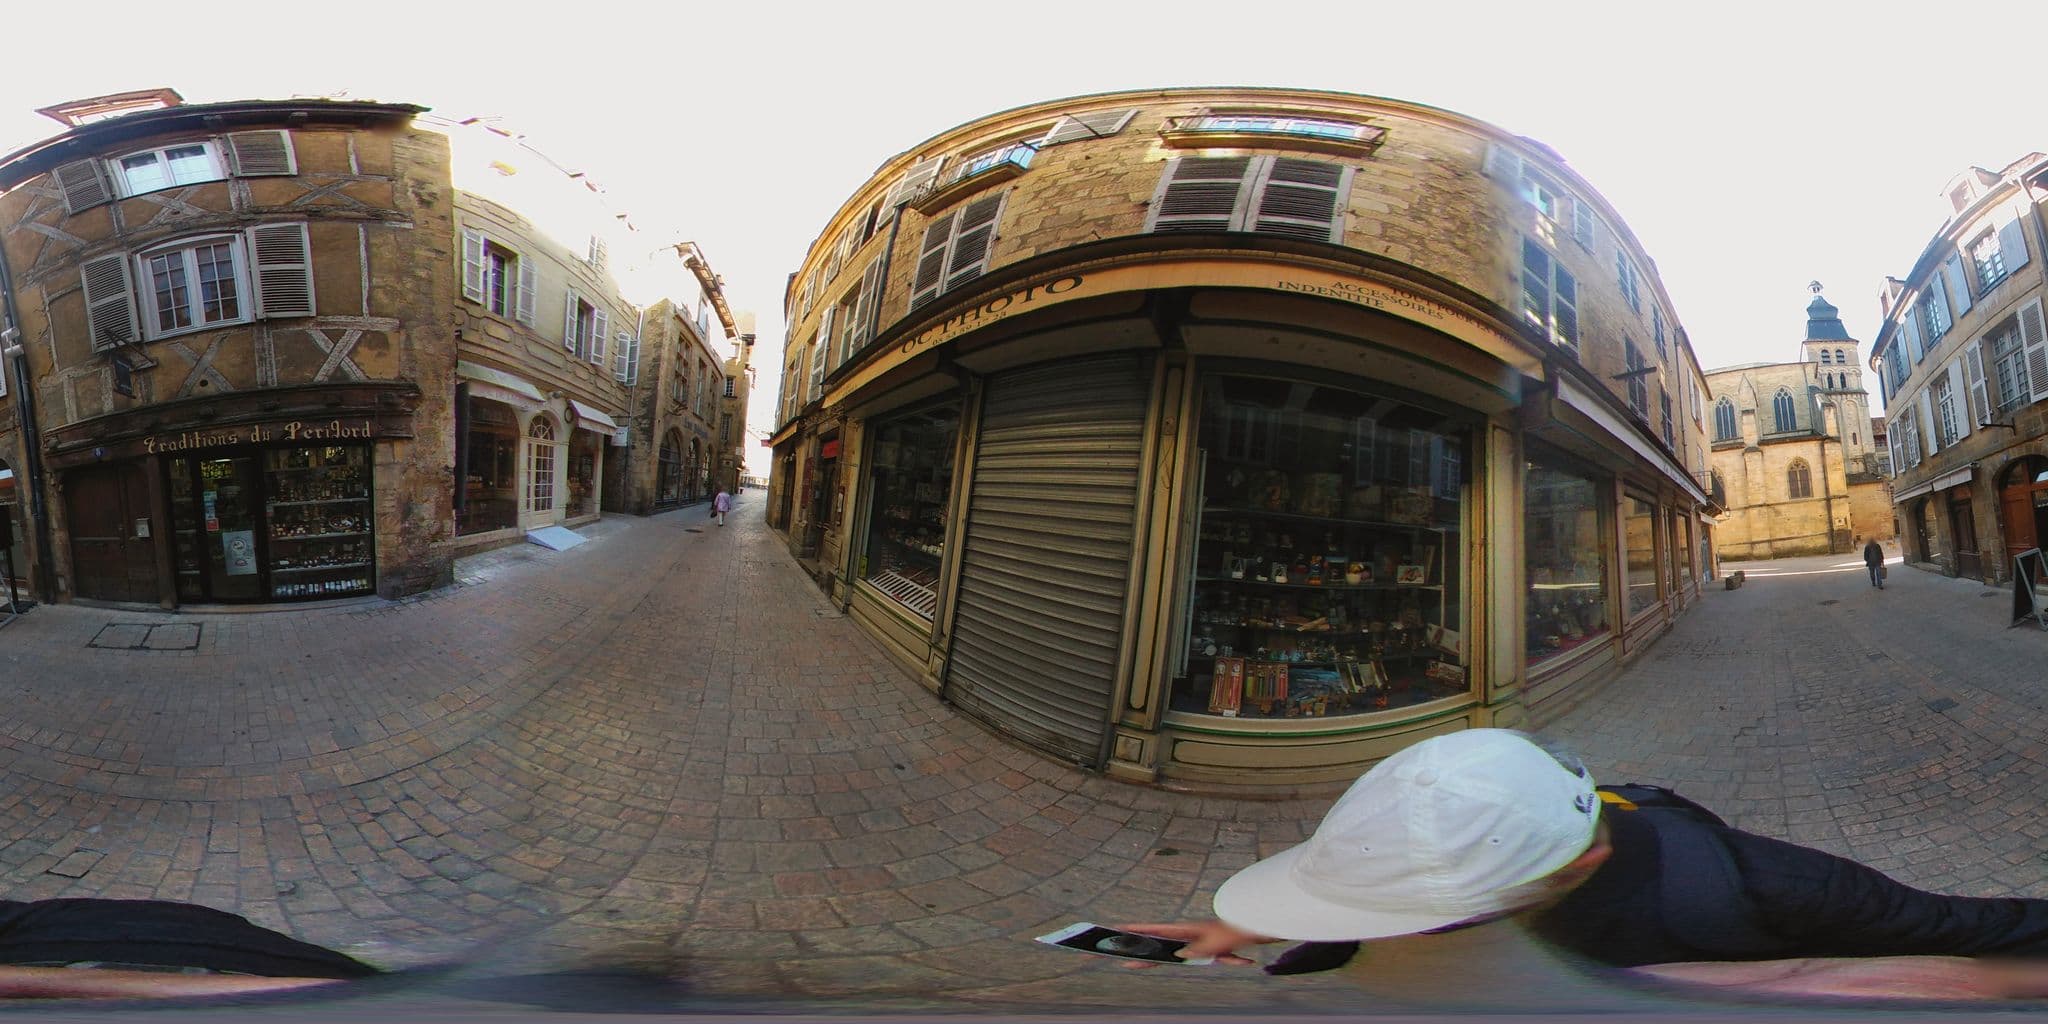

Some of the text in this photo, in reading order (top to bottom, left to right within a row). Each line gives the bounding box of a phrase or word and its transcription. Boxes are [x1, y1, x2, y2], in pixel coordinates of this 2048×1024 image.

[1278, 281, 1385, 309] INDENTITE
[1332, 281, 1445, 320] ACCESSOIRES
[901, 274, 1084, 354] OC PHOTO
[143, 431, 240, 454] Traditions
[250, 424, 271, 442] du
